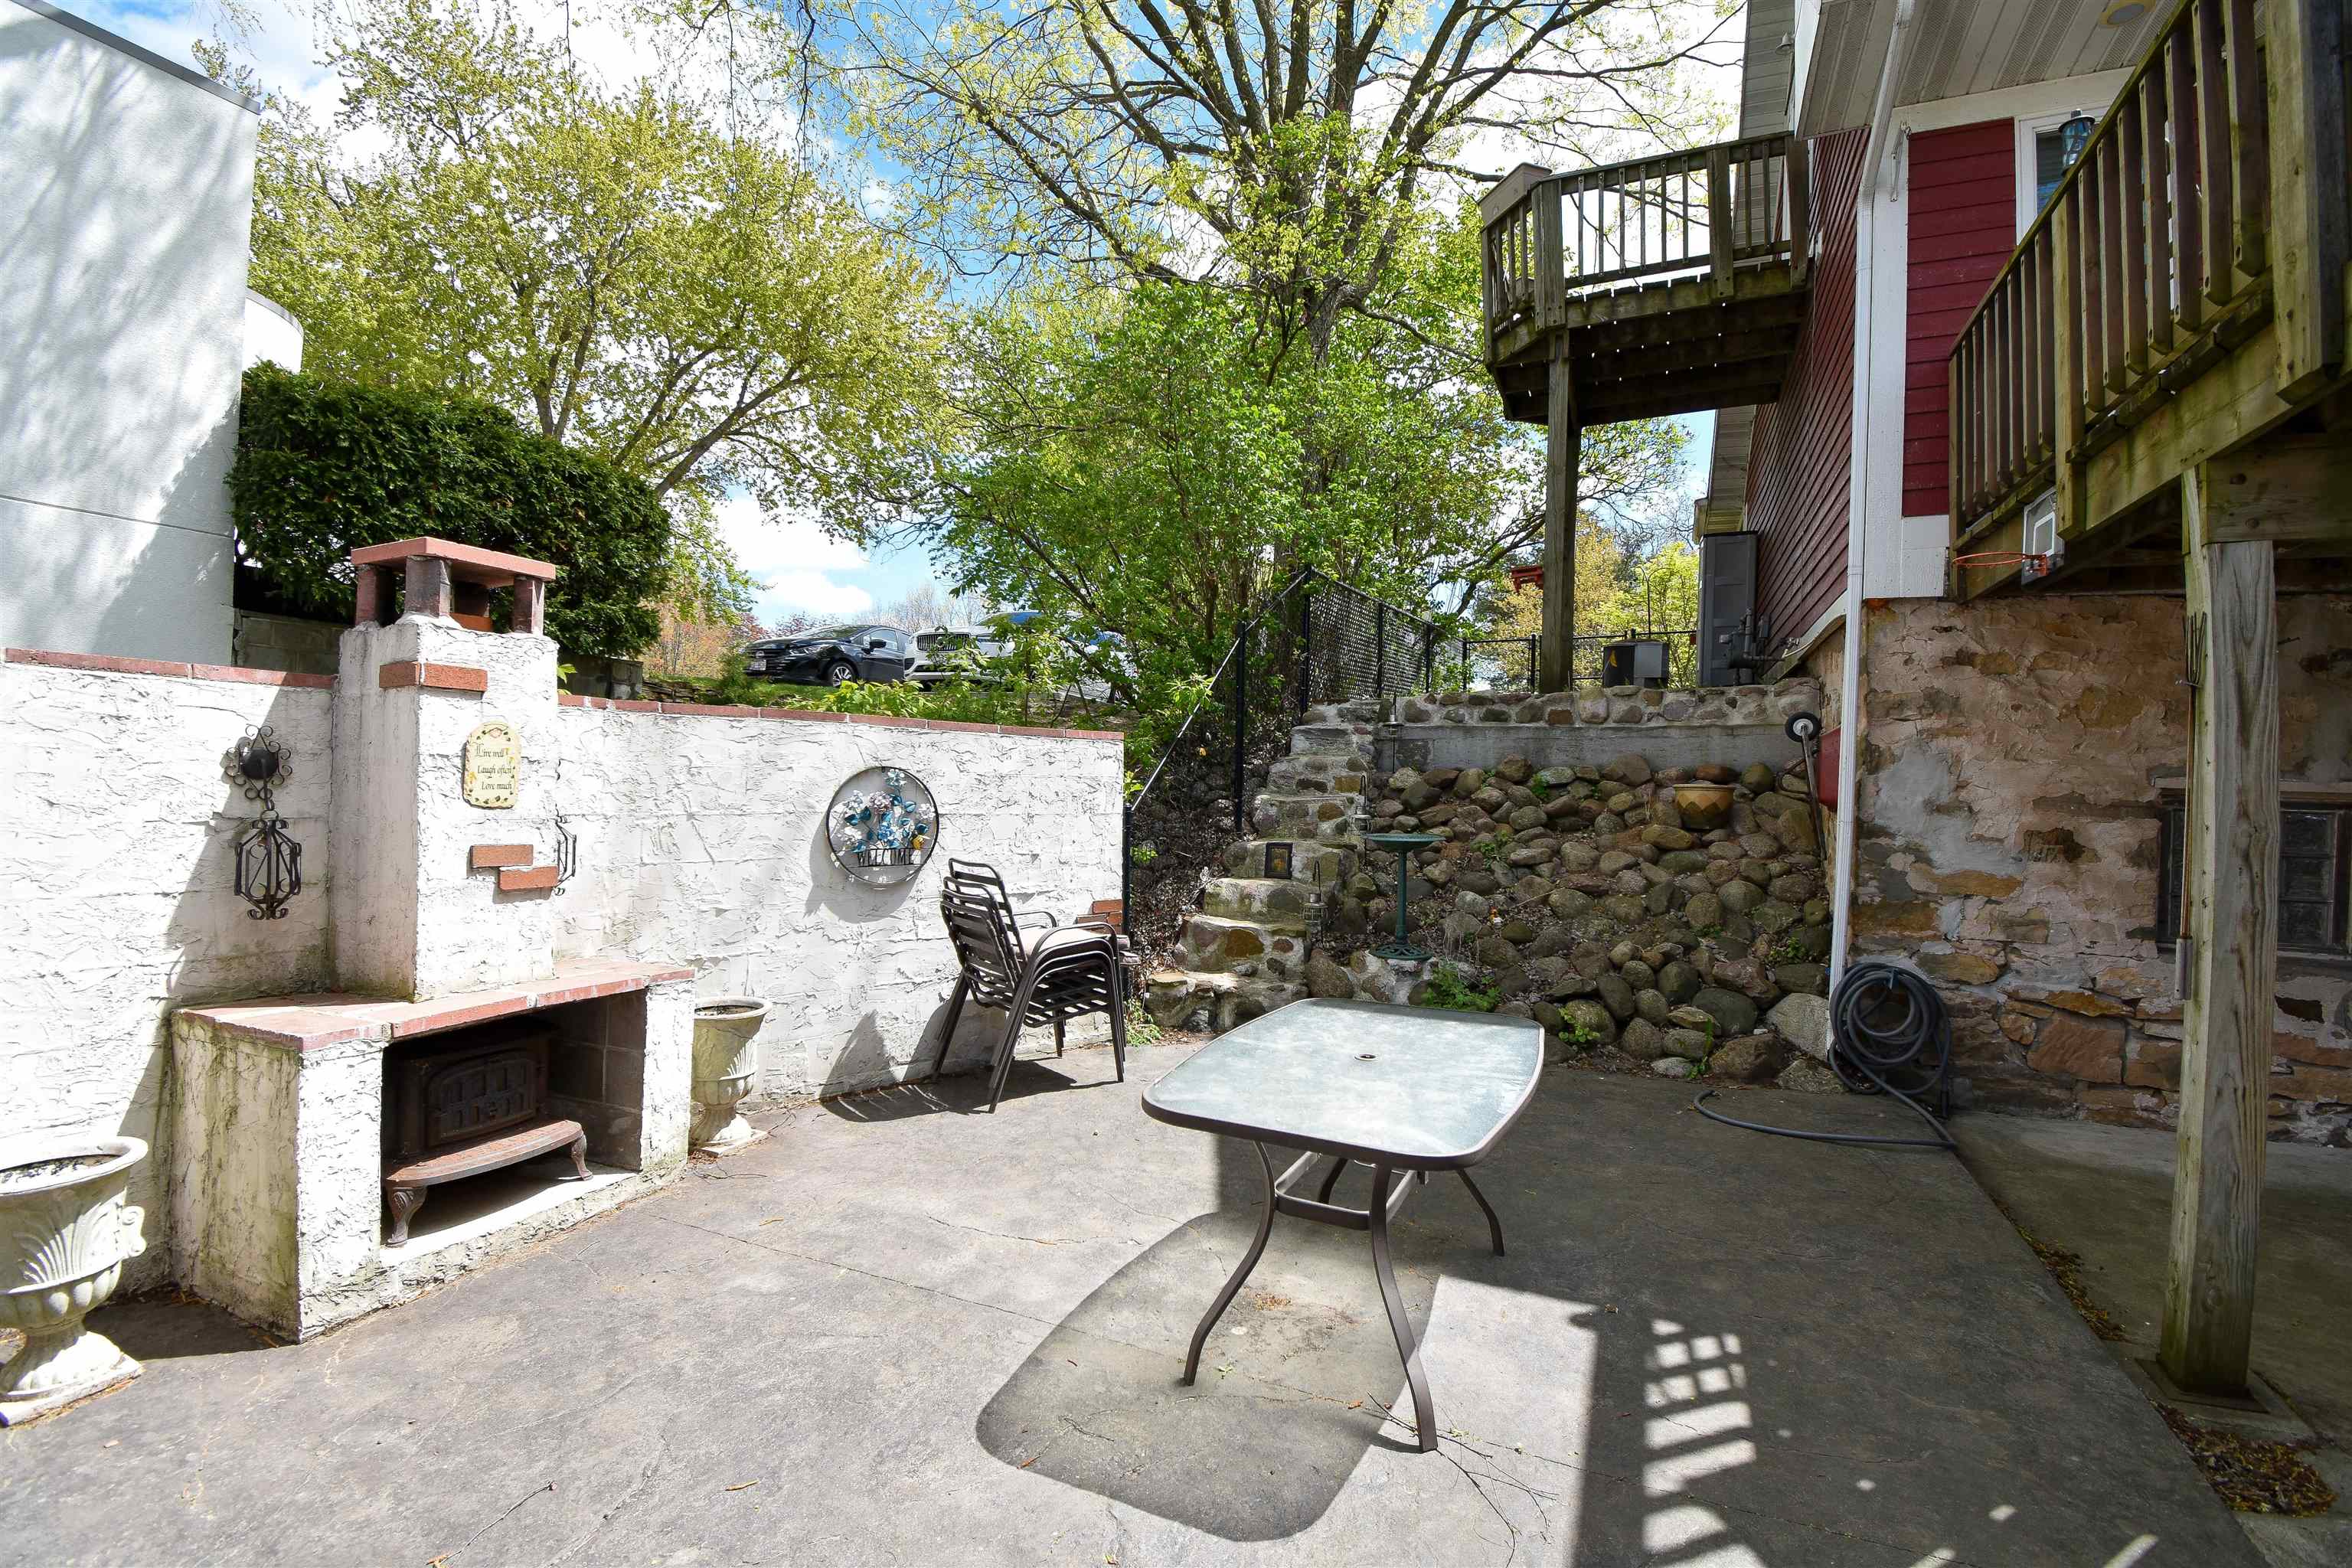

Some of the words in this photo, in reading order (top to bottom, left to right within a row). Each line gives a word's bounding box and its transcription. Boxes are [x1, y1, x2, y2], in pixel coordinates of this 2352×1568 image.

[492, 748, 504, 757] well
[478, 765, 495, 775] Laugh
[497, 765, 512, 776] often
[482, 782, 495, 790] Love
[496, 781, 512, 789] much
